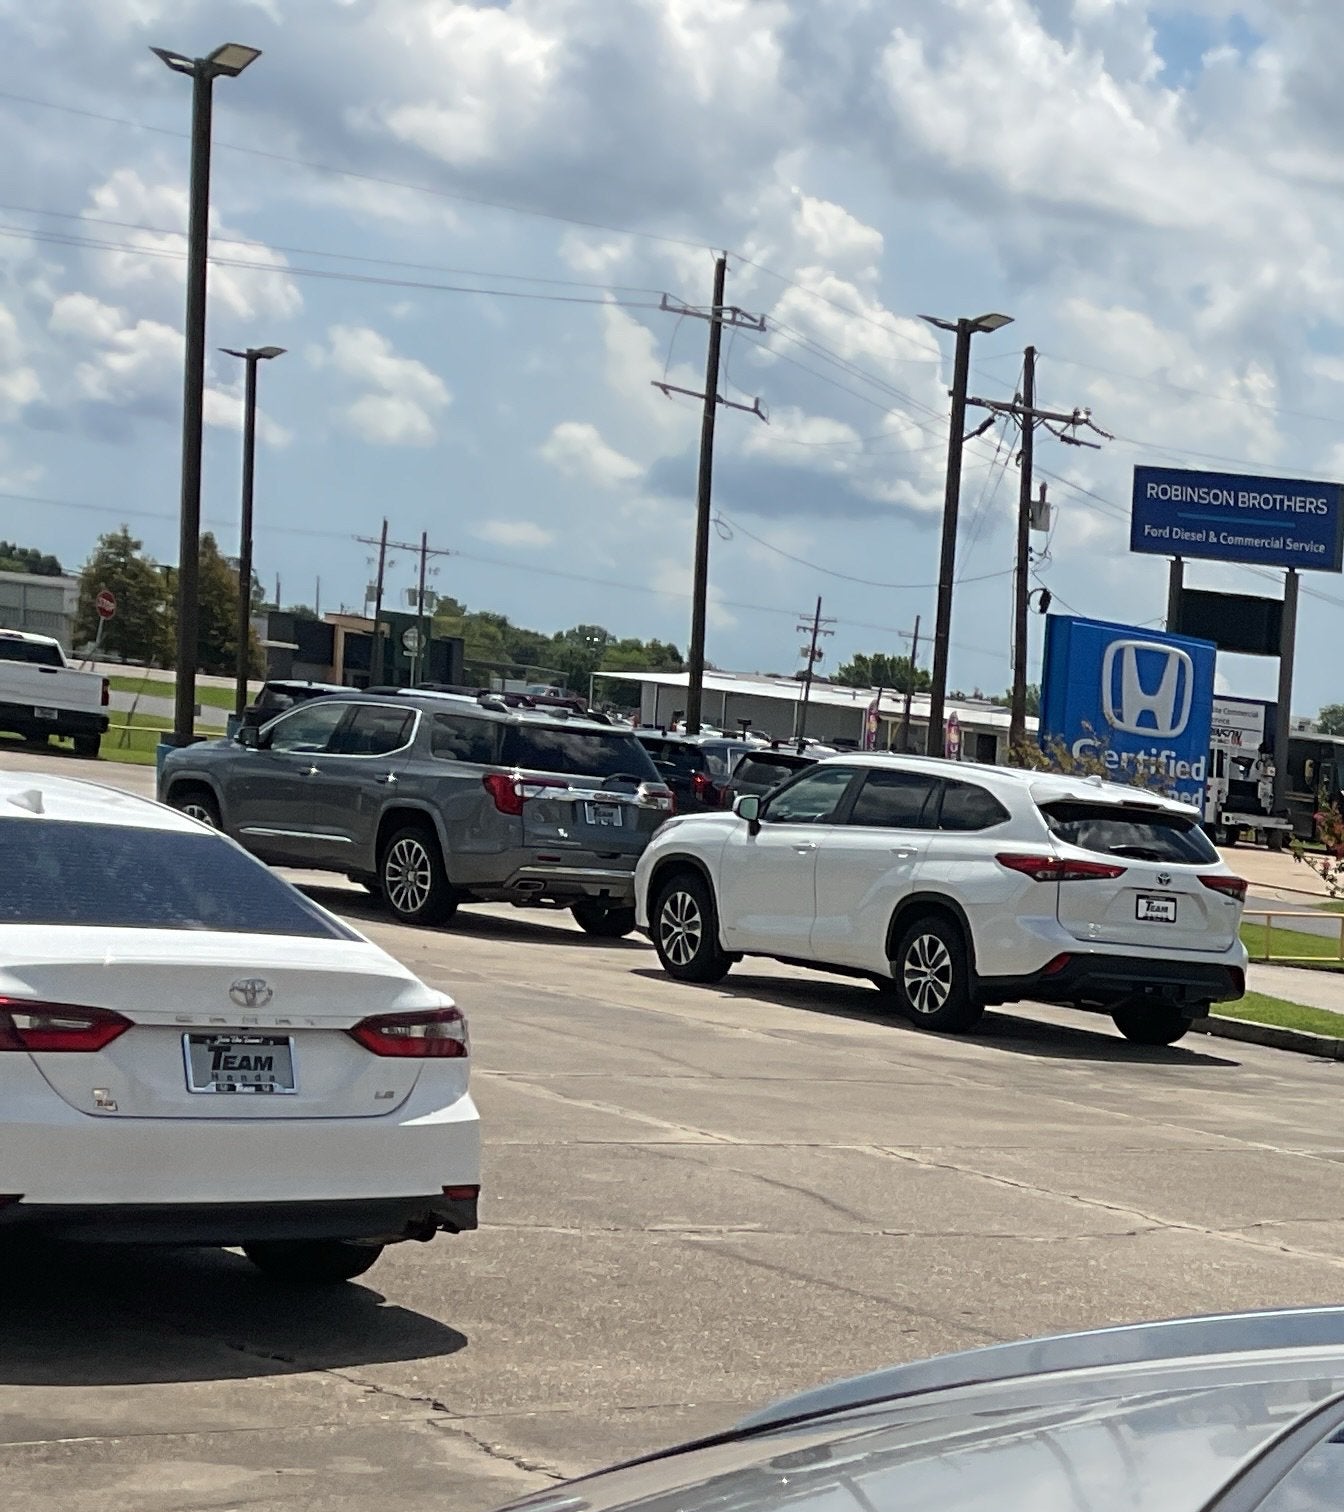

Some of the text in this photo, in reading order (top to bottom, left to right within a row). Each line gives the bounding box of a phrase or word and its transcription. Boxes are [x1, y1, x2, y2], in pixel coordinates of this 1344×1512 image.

[1146, 483, 1328, 515] ROBINSON BROTHERS
[1144, 524, 1327, 554] Ford Diesel & Commercial Service
[1072, 737, 1205, 781] Certified
